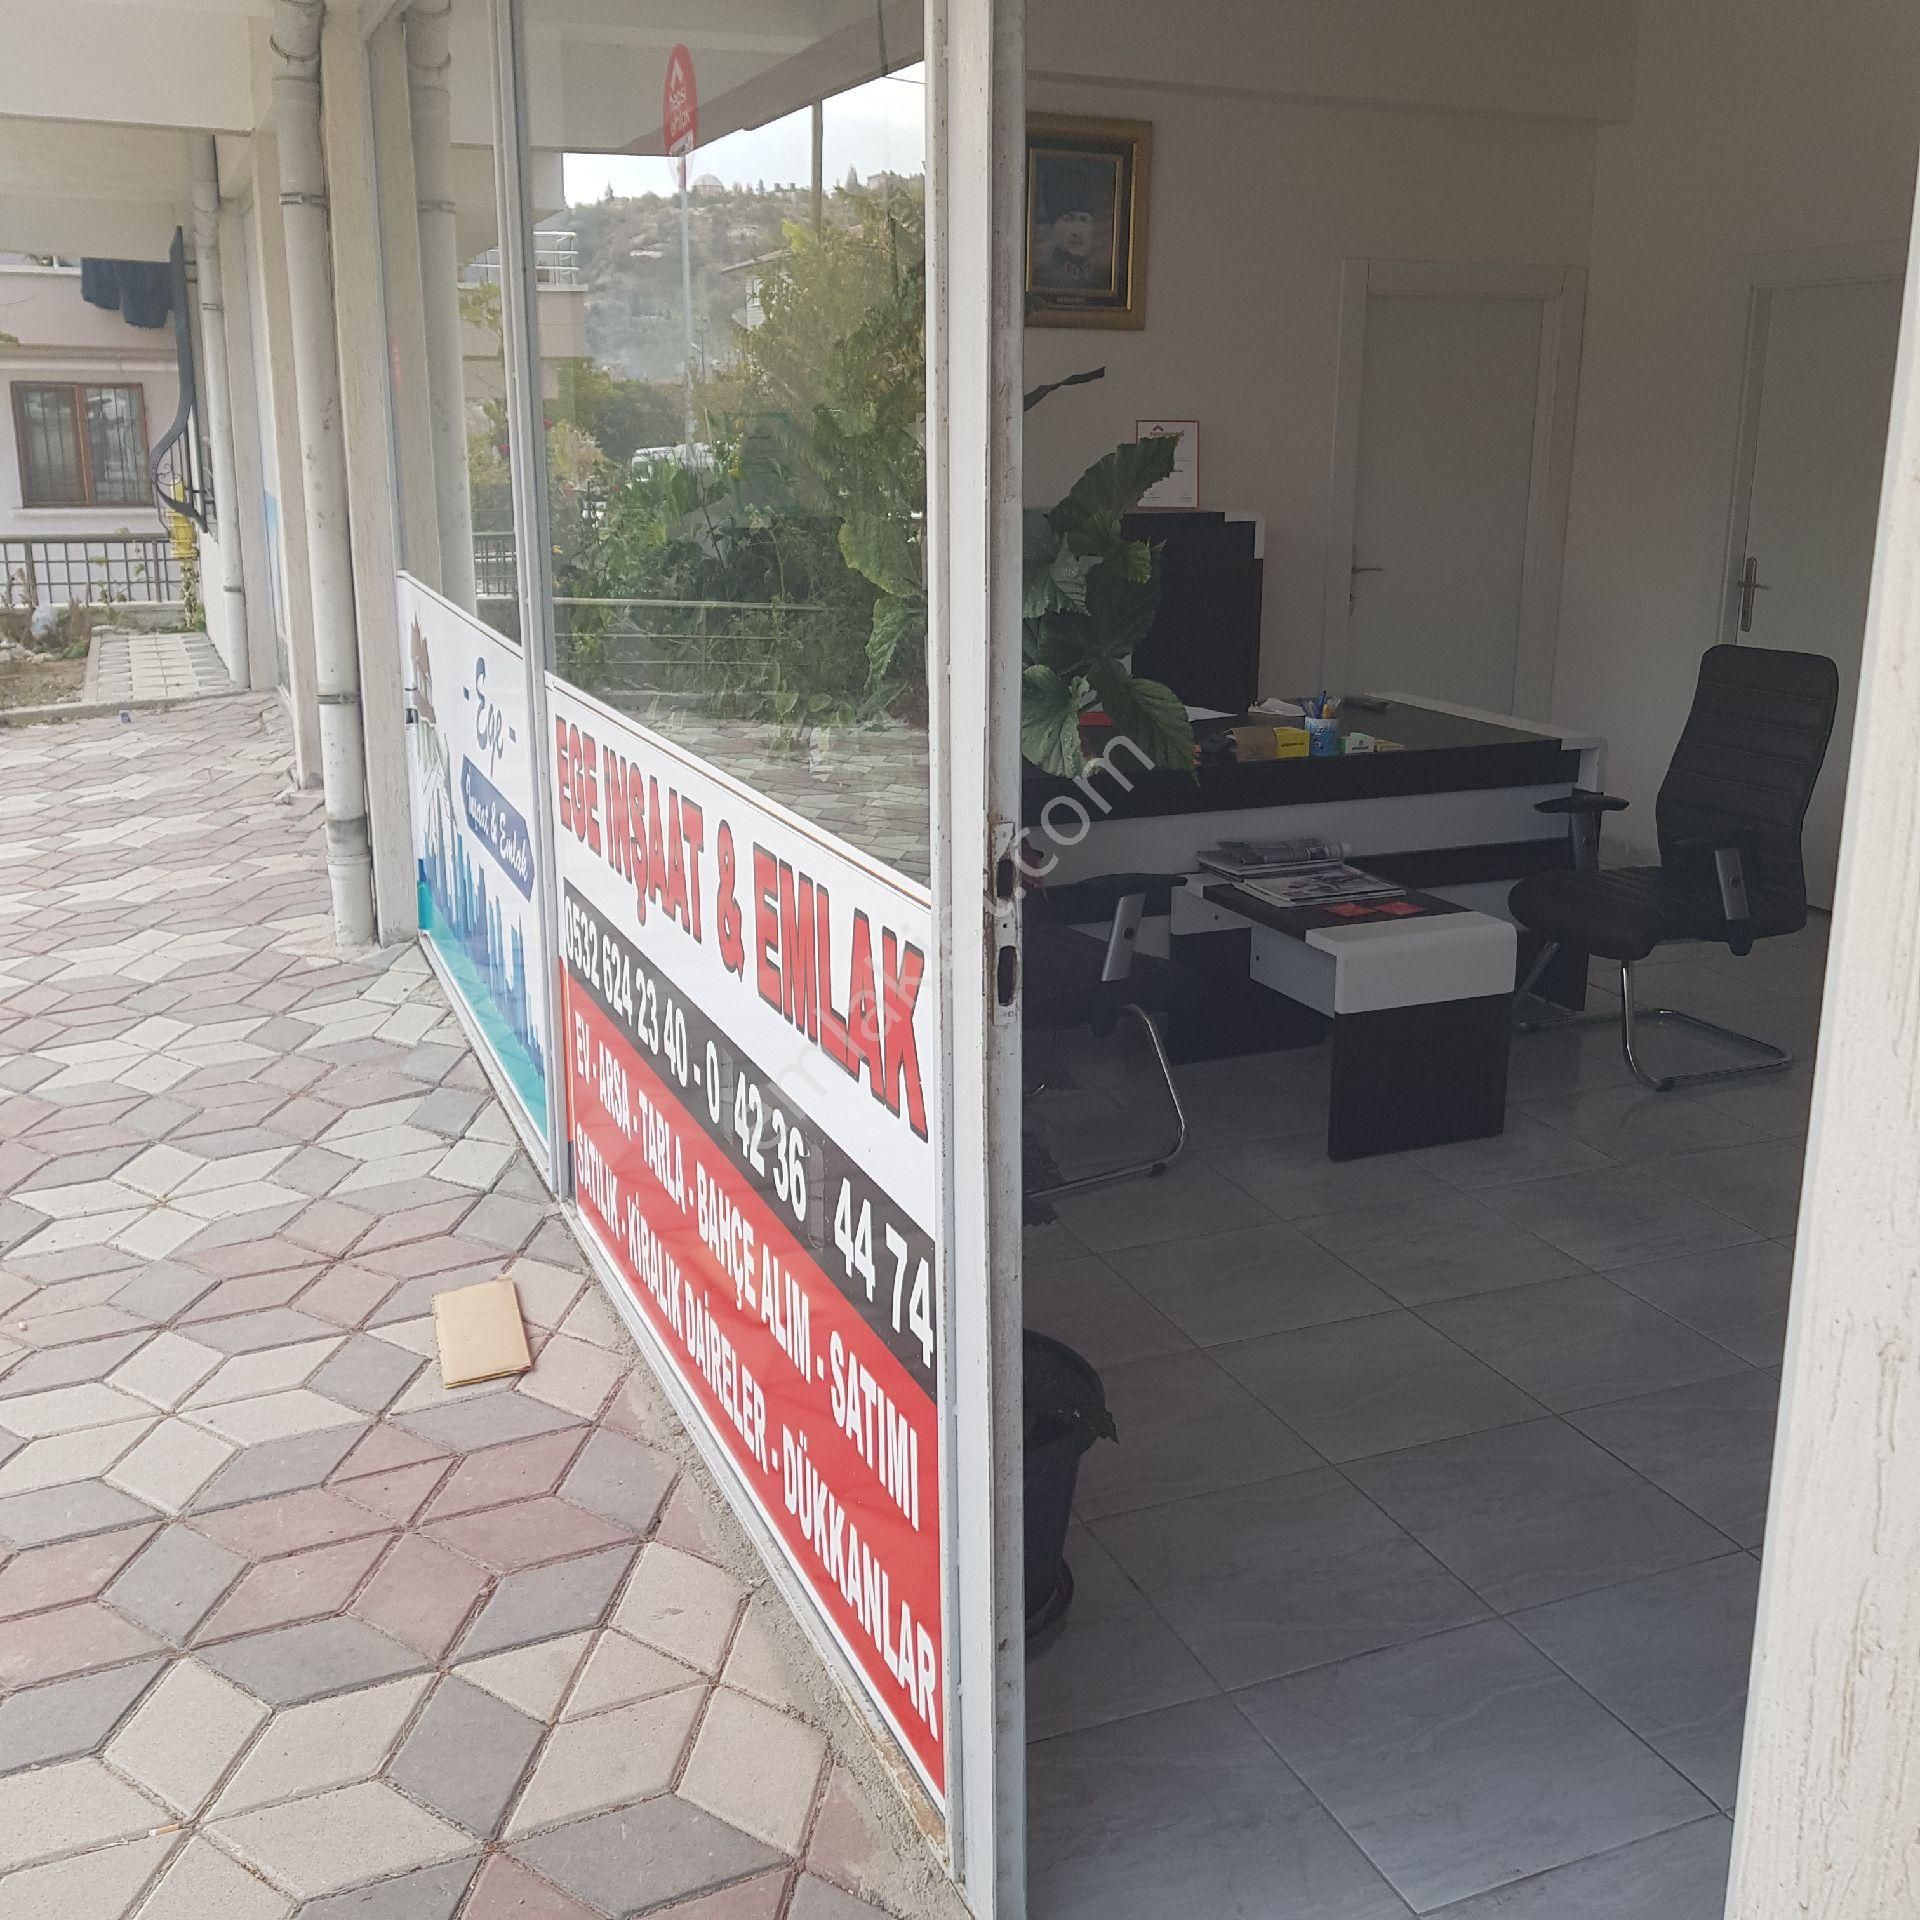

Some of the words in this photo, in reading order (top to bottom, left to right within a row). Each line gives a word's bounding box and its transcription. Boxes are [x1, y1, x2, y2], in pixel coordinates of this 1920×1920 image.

[475, 656, 504, 778] Ege
[489, 801, 499, 846] &
[499, 811, 528, 883] Emlak
[555, 714, 601, 858] EGE
[716, 819, 745, 982] &
[753, 841, 929, 1144] EMLAK
[564, 895, 600, 991] 0532
[602, 933, 633, 1027] 624
[635, 967, 659, 1055] 23
[663, 998, 687, 1087] 40
[834, 1177, 876, 1303] 44
[885, 1222, 934, 1369] 74
[574, 1010, 590, 1084] EV
[598, 1040, 631, 1141] ARSA
[638, 1088, 687, 1215] TARLA
[696, 1160, 757, 1311] BAHÇE
[760, 1243, 812, 1384] ALIM
[829, 1330, 919, 1532] SATIMI
[575, 1122, 621, 1241] SATILIK
[626, 1191, 684, 1341] KİRALIK
[684, 1279, 769, 1475] DAİRELER
[782, 1423, 939, 1742] DÜKKANLAR
